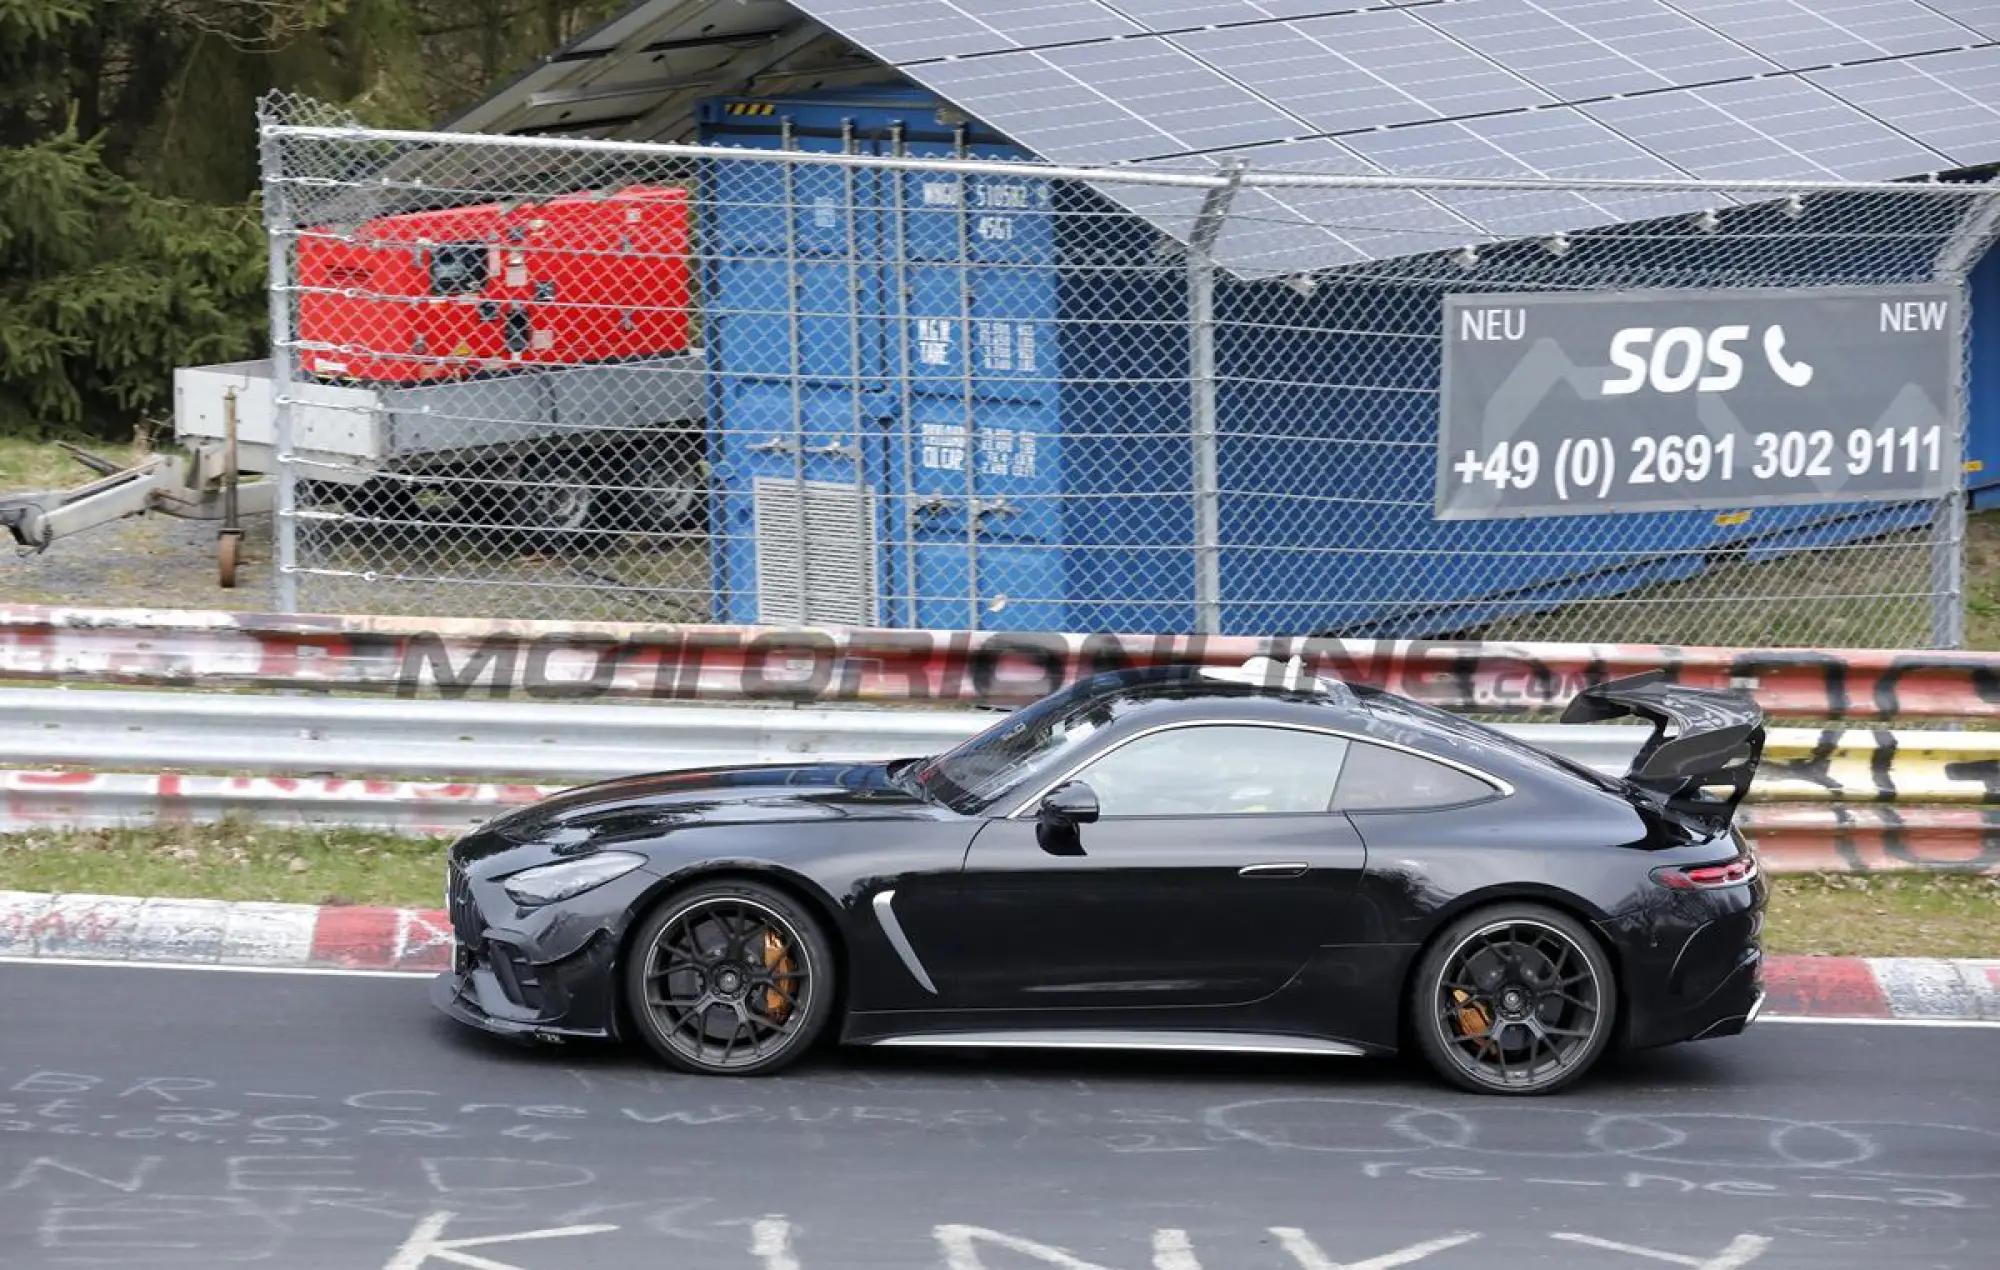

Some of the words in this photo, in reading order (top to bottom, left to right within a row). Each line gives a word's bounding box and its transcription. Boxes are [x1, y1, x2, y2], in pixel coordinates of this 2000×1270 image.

[1461, 309, 1526, 341] NEU
[1880, 301, 1947, 332] NEW
[1602, 325, 1749, 395] SOS
[1454, 441, 1539, 489] +49
[1555, 437, 1614, 500] (0)
[1629, 433, 1735, 484] 2691
[1752, 429, 1833, 478] 302
[1846, 425, 1941, 476] 9111
